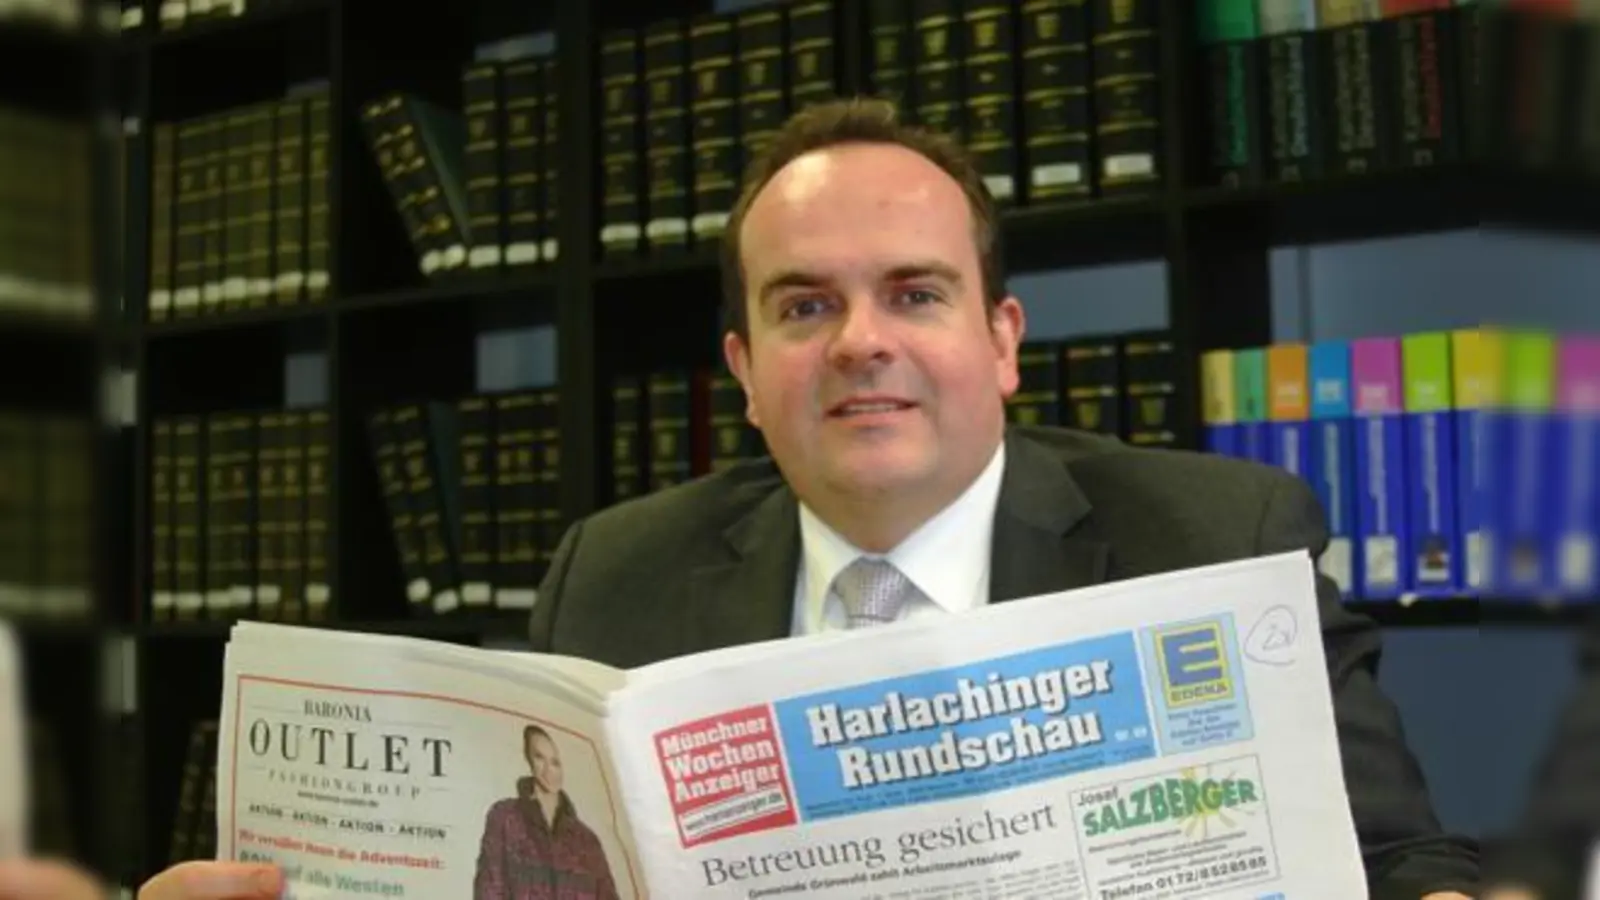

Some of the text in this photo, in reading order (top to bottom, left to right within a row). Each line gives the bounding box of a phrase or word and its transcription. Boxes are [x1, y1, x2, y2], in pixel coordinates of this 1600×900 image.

[304, 700, 372, 722] BARONIA
[805, 659, 1114, 747] Harlachinger
[1170, 681, 1228, 703] EDEKA
[249, 717, 452, 777] OUTLET
[661, 717, 768, 758] Münchner
[837, 712, 1105, 789] Rundschau
[665, 739, 774, 783] Wochen
[675, 763, 780, 803] Anzeiger
[1078, 786, 1118, 806] Josef
[1082, 778, 1259, 837] SALZBERGER
[338, 819, 385, 833] AKTION
[399, 825, 446, 839] AKTION
[701, 835, 886, 887] Betreuung
[896, 802, 1057, 862] gesichert
[1099, 881, 1154, 900] Telefon
